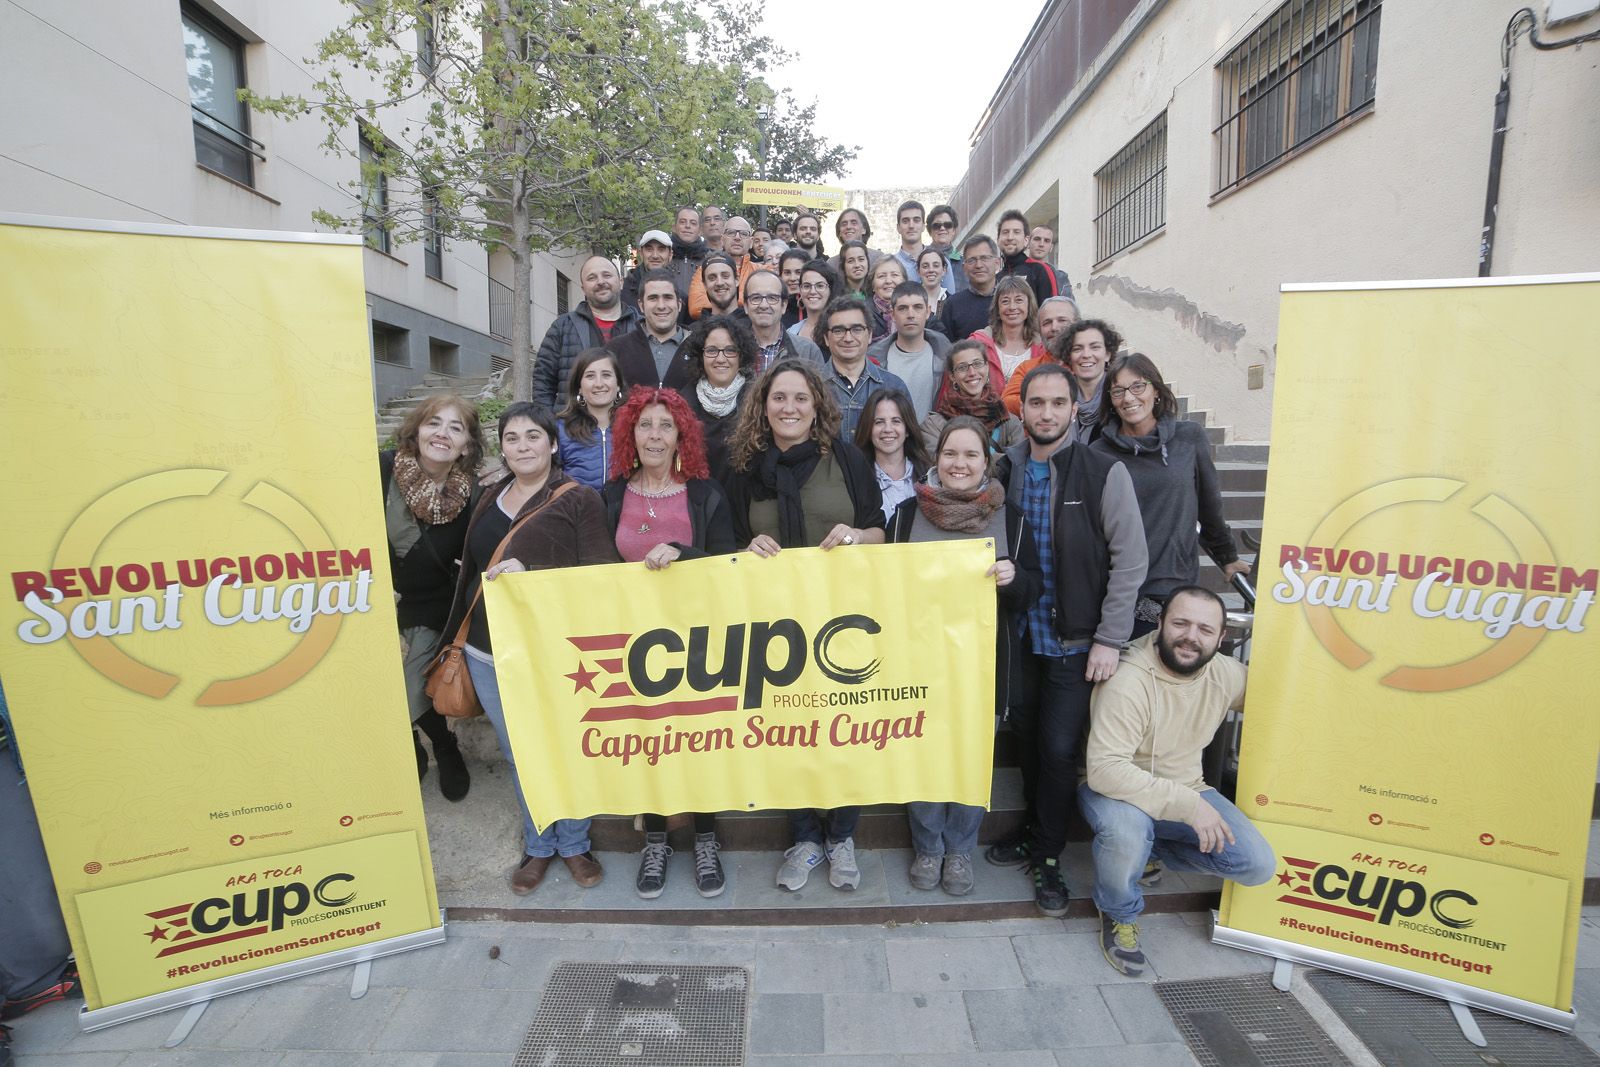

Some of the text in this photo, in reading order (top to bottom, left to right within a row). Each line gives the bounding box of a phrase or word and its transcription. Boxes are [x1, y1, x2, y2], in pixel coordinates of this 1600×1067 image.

[11, 548, 373, 602] REVOLUCIONEM
[1279, 545, 1599, 595] REVOLUCIONEM
[17, 569, 373, 644] Sant Cugat
[1272, 559, 1595, 640] Sant Cugat
[581, 710, 928, 767] Capgirem Sant Cugat
[209, 810, 229, 820] Més
[232, 802, 284, 818] informació
[1359, 785, 1377, 796] Més
[1380, 788, 1429, 804] informació
[225, 864, 303, 888] ARA TOCA
[1351, 852, 1428, 875] ARA TOCA
[166, 921, 382, 979] #RevolucionemSantCugat
[1279, 916, 1493, 975] #RevolucionemSantCugat
